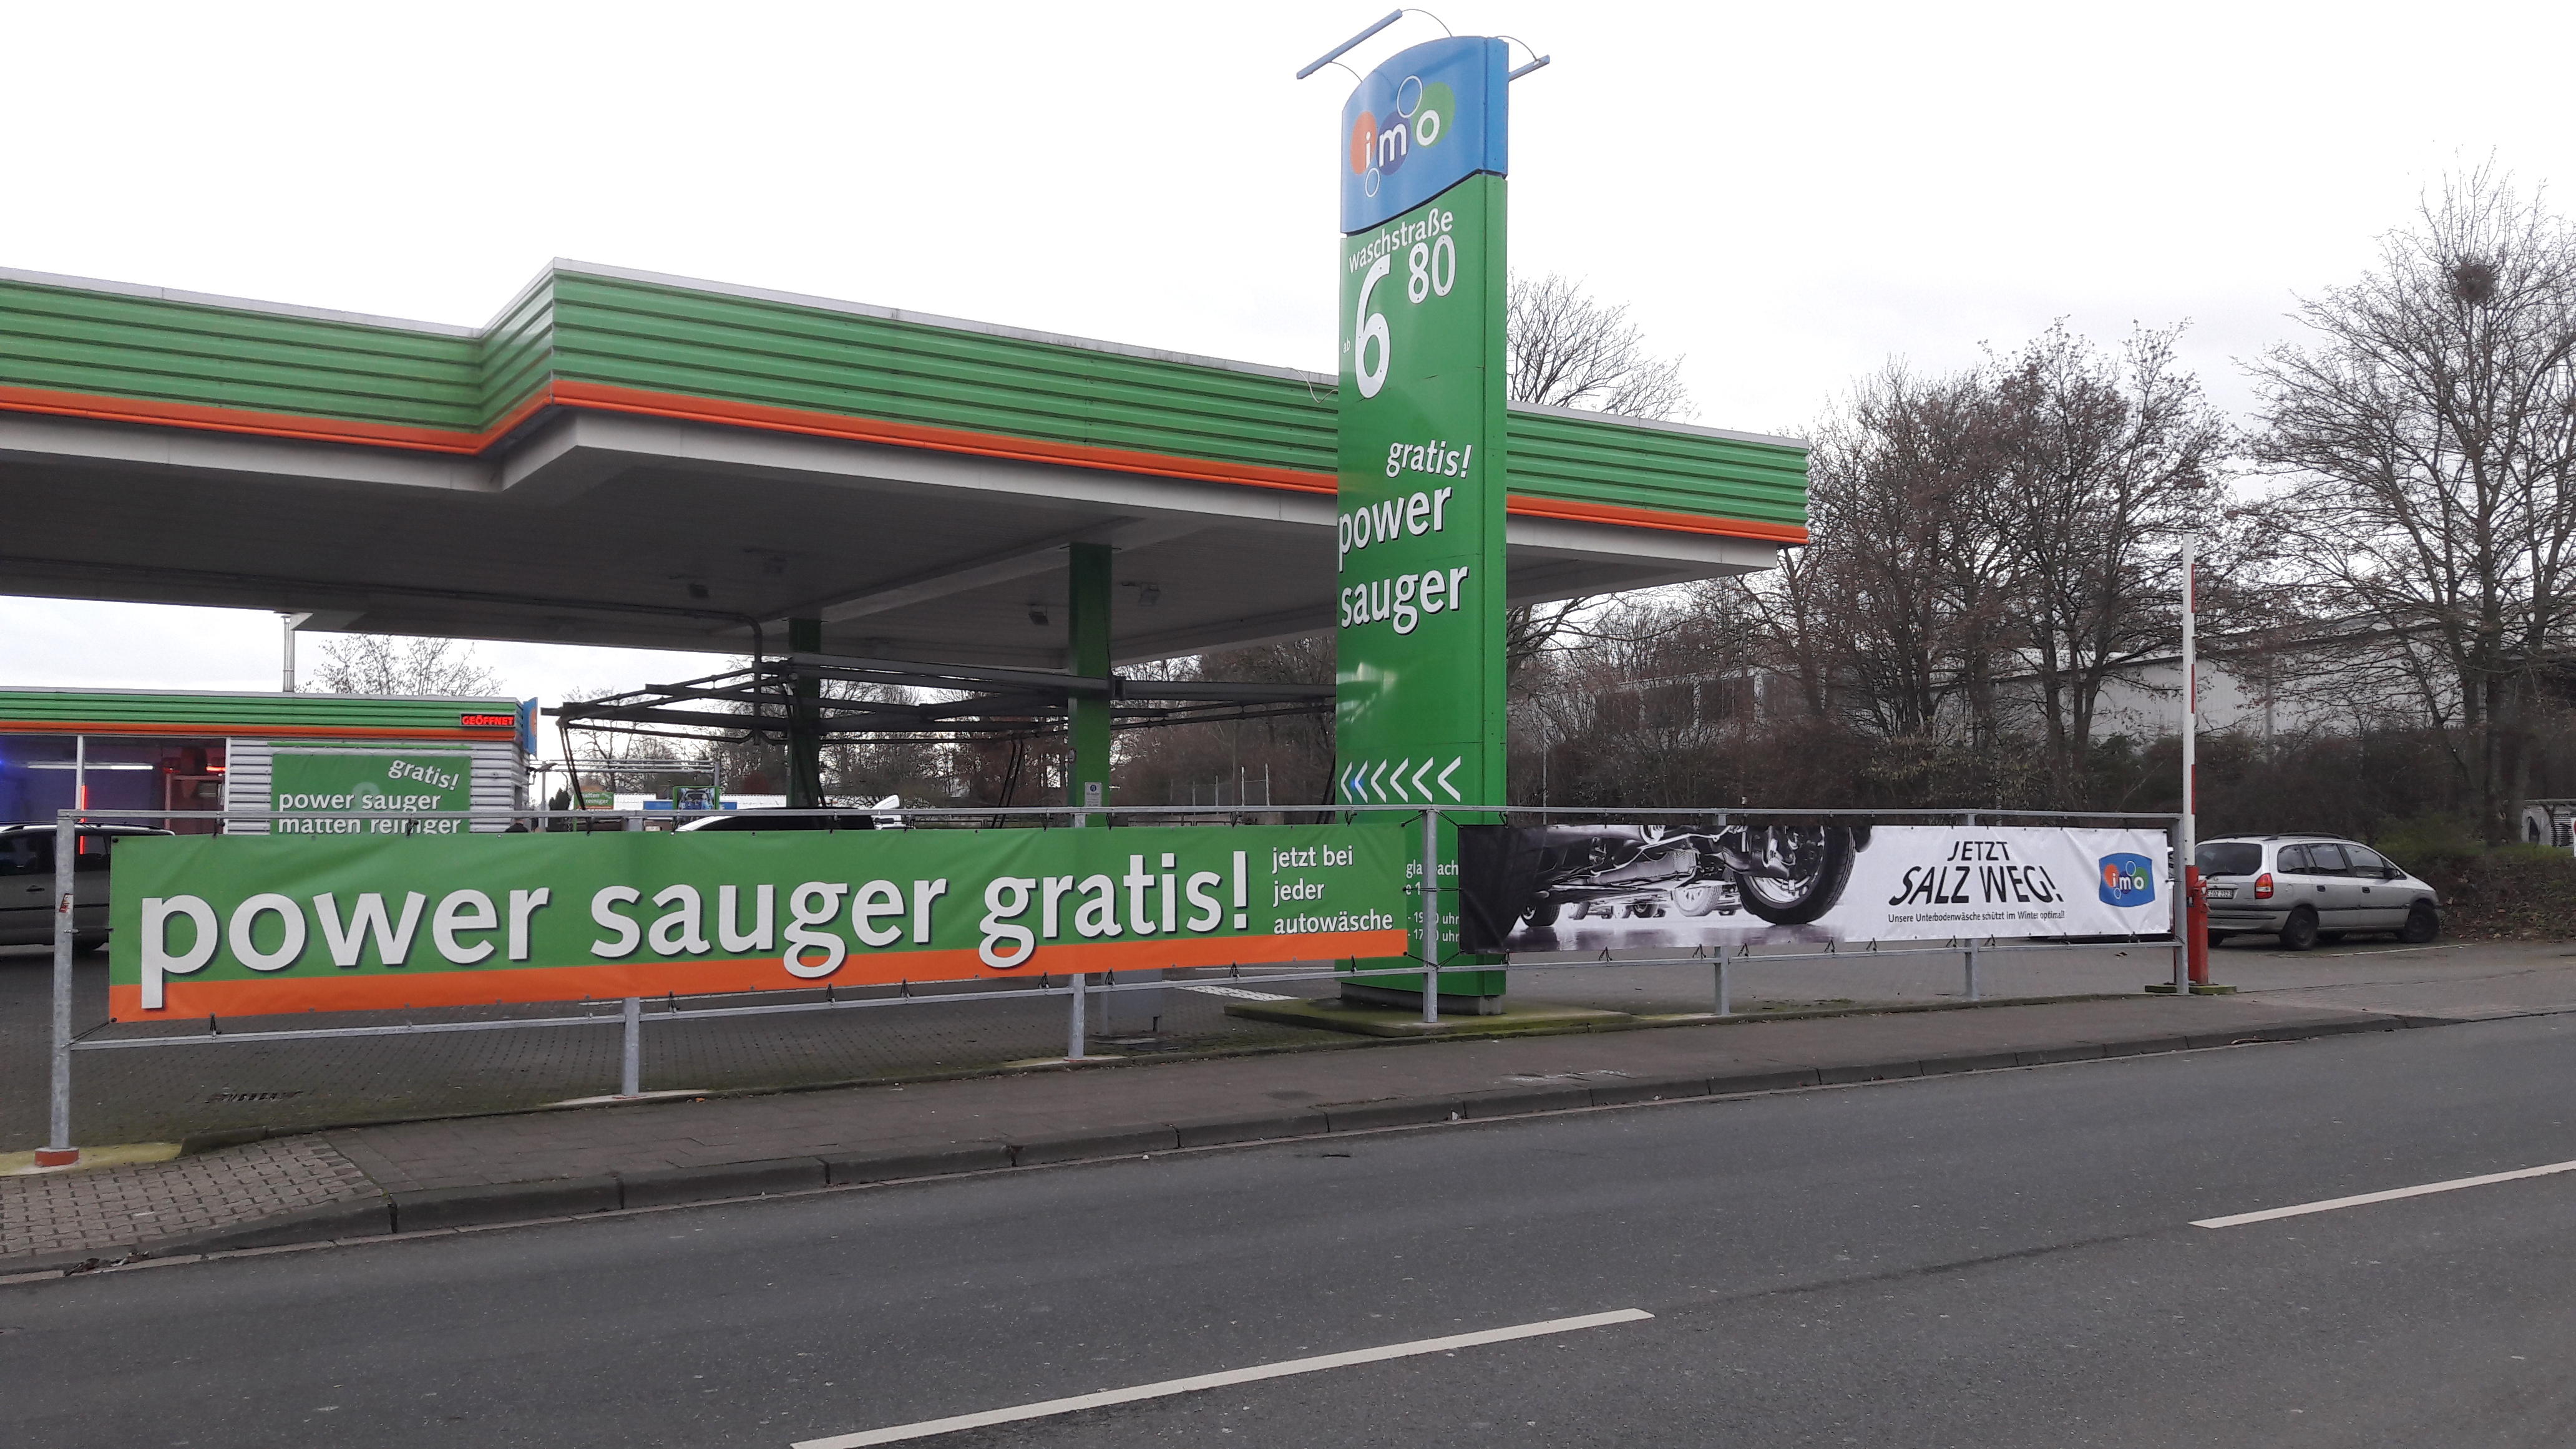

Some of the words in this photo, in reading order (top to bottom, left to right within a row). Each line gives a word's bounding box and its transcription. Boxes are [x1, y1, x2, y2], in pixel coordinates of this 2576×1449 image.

[1365, 109, 1440, 170] imo
[1349, 207, 1453, 273] waschstraße
[1342, 337, 1351, 354] ab
[1355, 253, 1391, 398] 6
[1408, 234, 1456, 305] 80
[1386, 439, 1472, 478] gratis!
[1339, 486, 1452, 573] power
[1341, 566, 1469, 635] sauger
[462, 715, 514, 725] GEÖFFNET
[388, 759, 460, 791] gratis!
[279, 793, 355, 811] power
[361, 794, 442, 811] sauger
[278, 818, 361, 834] matten
[1272, 847, 1317, 874] jetzt
[1323, 844, 1354, 867] bei
[1947, 841, 2011, 861] JETZT
[1272, 877, 1325, 908] jeder
[1888, 866, 1971, 906] SALZ
[1979, 866, 2064, 903] WEG!
[2112, 873, 2144, 890] imo
[141, 887, 550, 1009] power
[590, 878, 947, 978] sauger
[978, 851, 1247, 968] gratis!
[1274, 908, 1393, 935] autowäsche
[1888, 914, 1913, 922] Unsere
[1916, 911, 1981, 922] Unterbodenwäsche
[1982, 911, 2004, 920] schützt
[2006, 911, 2016, 919] im
[2017, 910, 2038, 919] Winter
